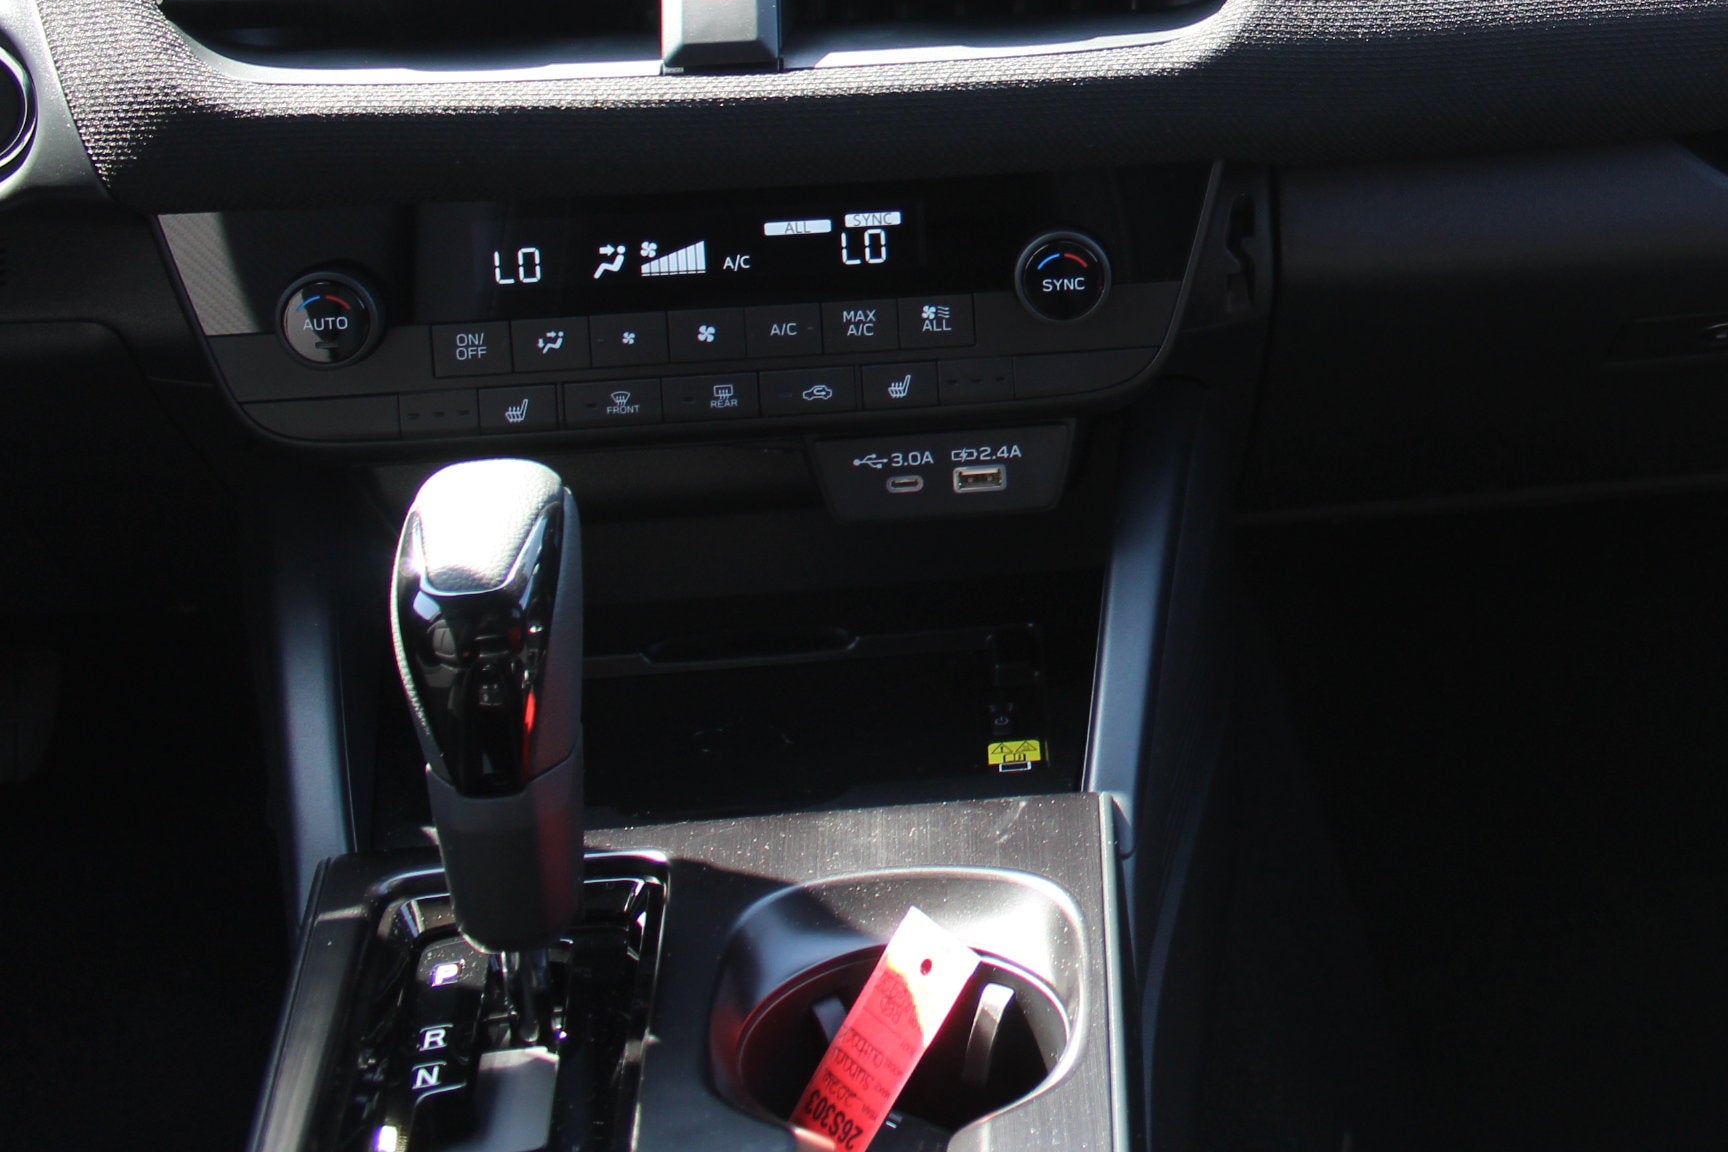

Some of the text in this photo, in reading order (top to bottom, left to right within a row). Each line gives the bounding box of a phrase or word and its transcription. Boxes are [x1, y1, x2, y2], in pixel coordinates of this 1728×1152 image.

[784, 212, 893, 234] ALL SYNC
[722, 255, 751, 272] A/C
[1042, 277, 1086, 292] SYNC
[303, 316, 348, 331] AUTO
[842, 309, 876, 323] MAX
[770, 322, 797, 336] A/C
[847, 323, 874, 337] A/C
[922, 318, 952, 332] ALL
[455, 332, 484, 346] ON/
[455, 347, 487, 361] OFF
[606, 404, 640, 415] FRONT
[710, 398, 738, 408] REAR
[890, 451, 934, 467] 3.0A
[979, 444, 1022, 461] 2.4A
[433, 963, 459, 986] P
[422, 1028, 447, 1050] R
[413, 1065, 441, 1088] N
[804, 1089, 863, 1150] 26S303
